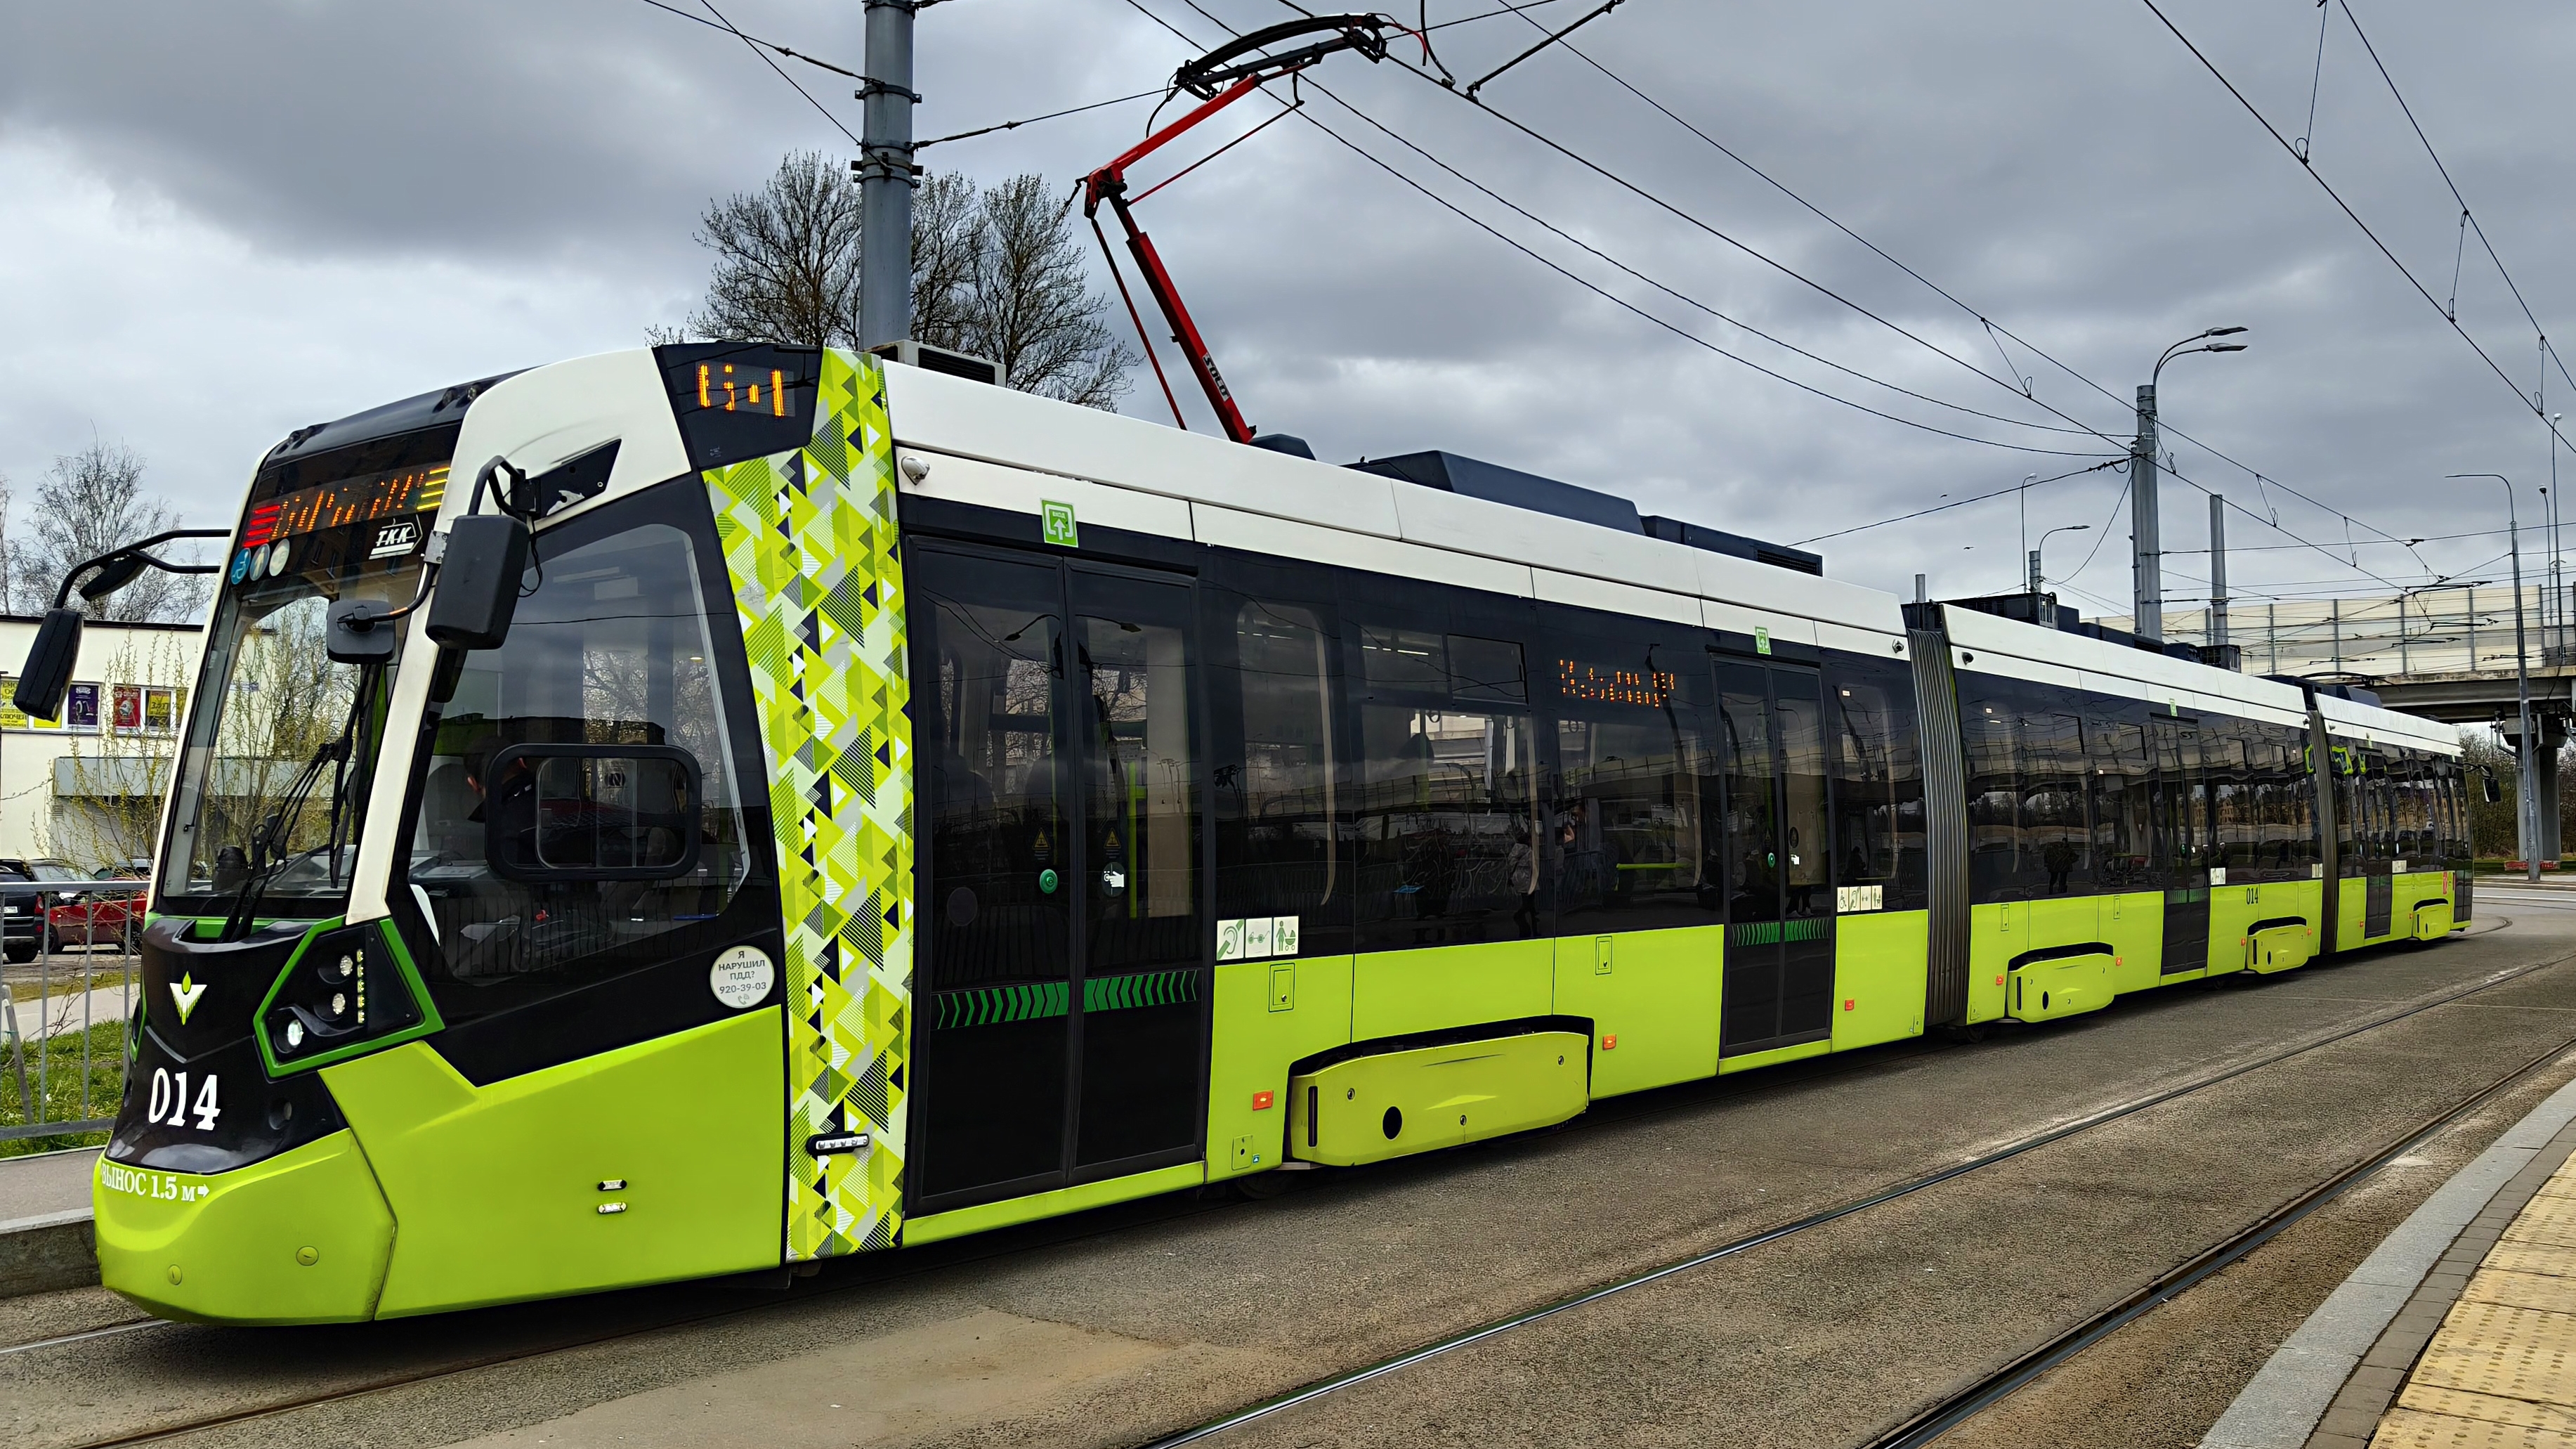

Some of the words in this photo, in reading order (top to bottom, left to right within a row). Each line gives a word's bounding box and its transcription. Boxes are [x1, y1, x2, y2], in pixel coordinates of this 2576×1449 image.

[2246, 887, 2259, 905] 014
[738, 950, 745, 959] Я
[718, 959, 766, 971] НАРУШИЛ
[730, 970, 755, 981] ПДД?
[719, 982, 767, 994] 920-39-03
[148, 1067, 221, 1131] 014
[101, 1162, 147, 1196] ВЫНОС
[150, 1175, 178, 1200] 1.5
